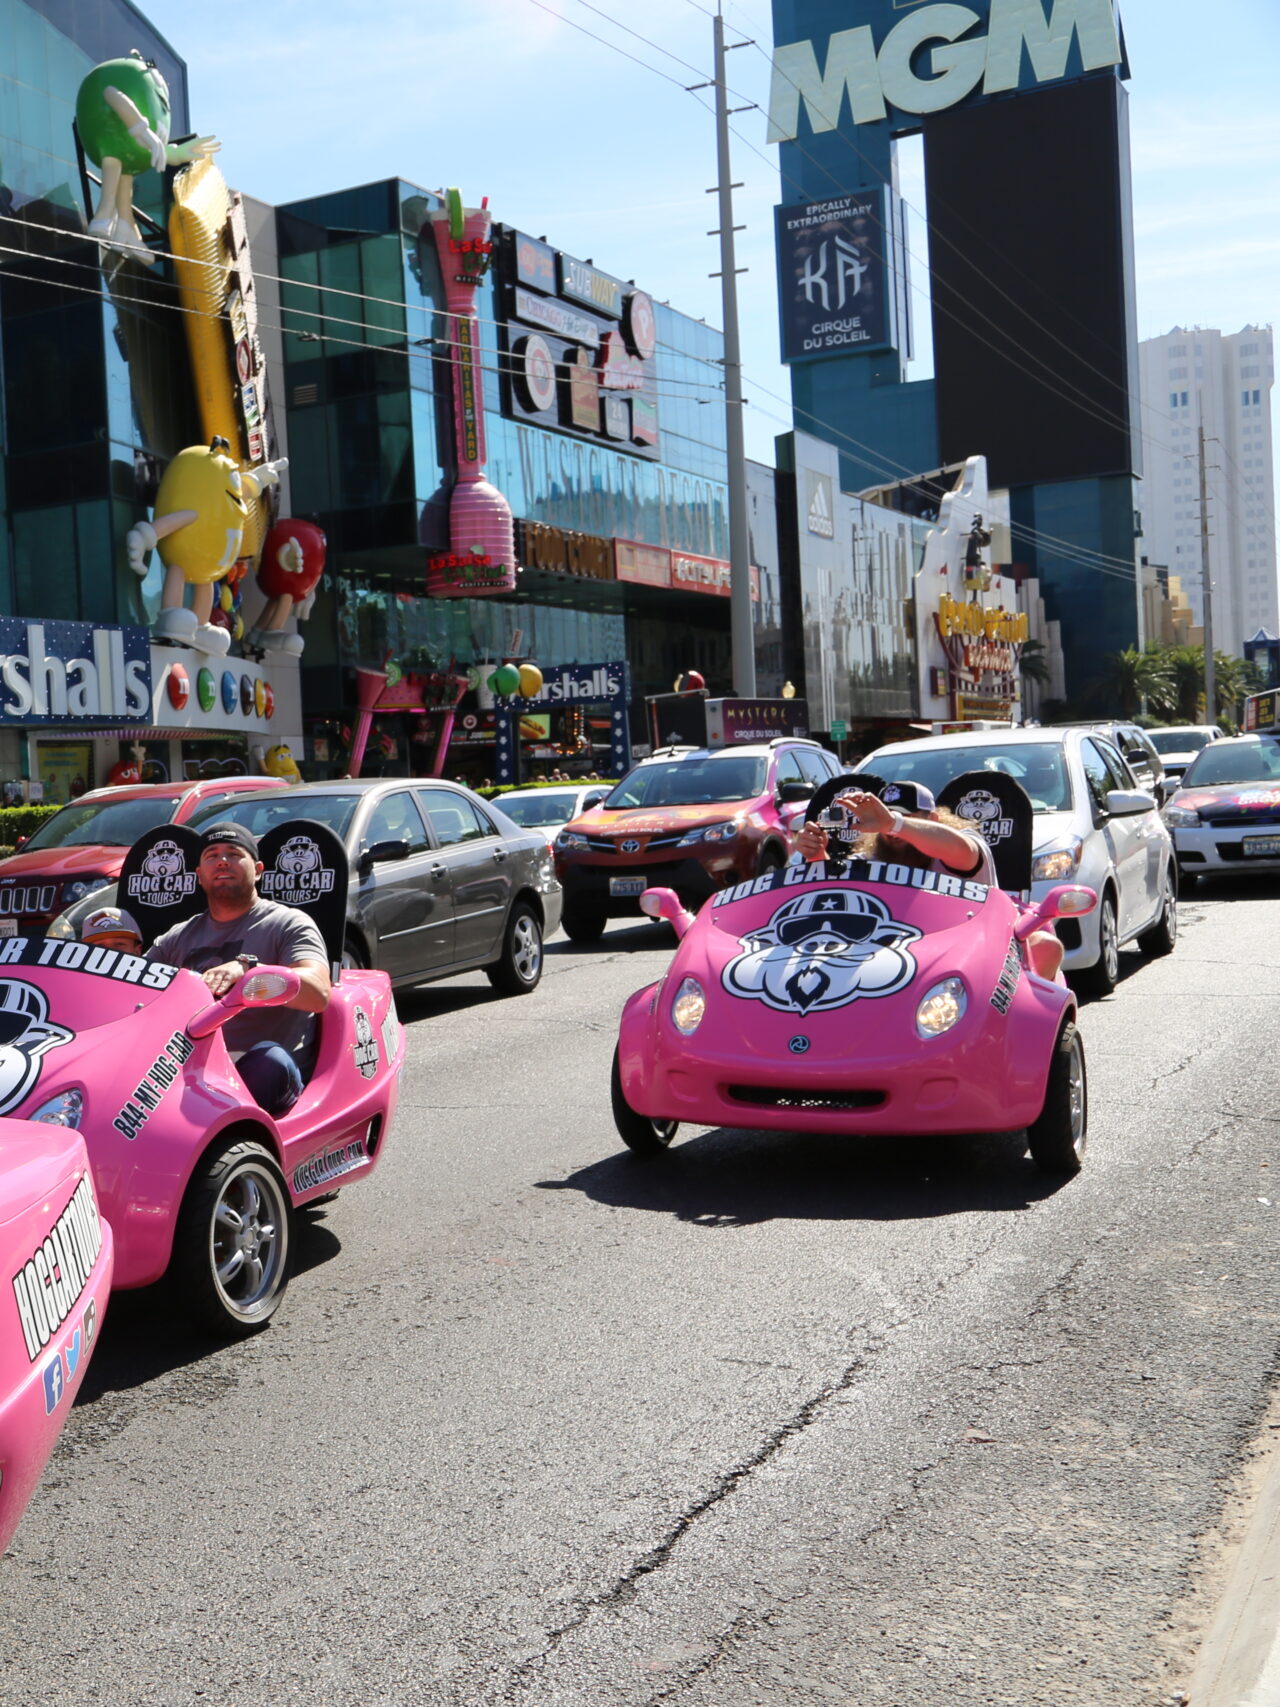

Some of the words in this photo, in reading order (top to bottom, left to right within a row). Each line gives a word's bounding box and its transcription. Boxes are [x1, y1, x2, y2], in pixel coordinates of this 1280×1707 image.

[766, 0, 1122, 144] MGM
[786, 204, 873, 230] EXTRAORDINARY
[806, 199, 852, 216] EPICALLY
[569, 265, 619, 308] SUBWAY
[811, 317, 862, 335] CIRQUE
[803, 337, 823, 350] DU
[825, 329, 871, 346] SOLEIL
[466, 420, 478, 457] YARD
[734, 730, 754, 740] CIRQUE
[756, 729, 764, 738] DU
[765, 729, 784, 738] SOLEIL
[131, 875, 161, 893] HOG
[163, 875, 196, 893] CAR
[263, 873, 296, 890] HOG
[299, 872, 333, 890] CAR
[713, 873, 774, 908] HOG
[867, 861, 988, 902] TOURS
[146, 892, 175, 903] TOURS
[281, 889, 312, 902] TOURS
[37, 938, 178, 989] TOURS
[113, 1031, 195, 1140] 844-MY-HOG-CAR
